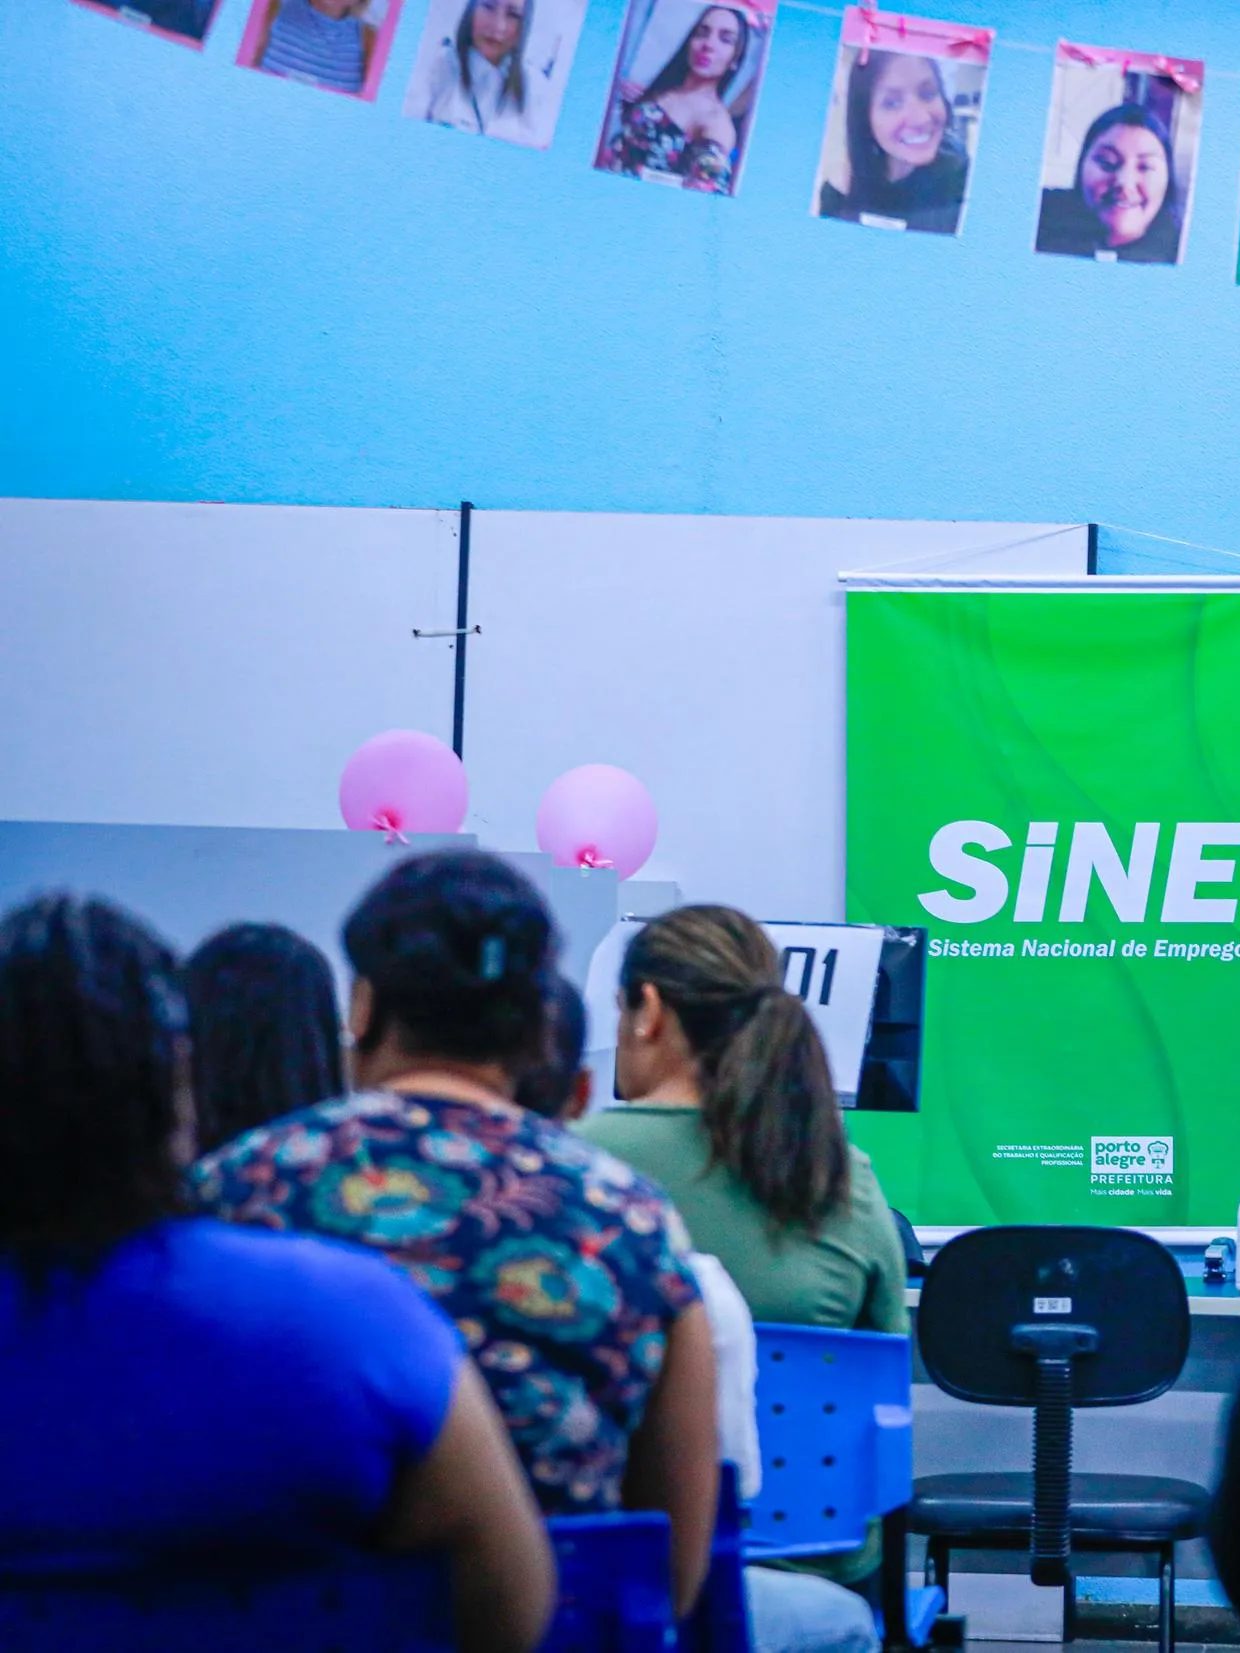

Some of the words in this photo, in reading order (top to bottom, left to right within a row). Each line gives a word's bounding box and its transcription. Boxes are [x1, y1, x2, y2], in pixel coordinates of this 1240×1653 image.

[928, 938, 1015, 958] Sistema
[1021, 939, 1116, 958] Nacional
[1121, 939, 1148, 958] de
[1095, 1140, 1141, 1155] porto
[1095, 1153, 1146, 1169] alegre
[1090, 1174, 1173, 1184] PREFEITURA
[1108, 1188, 1135, 1196] cidade
[1154, 1188, 1173, 1196] vida
